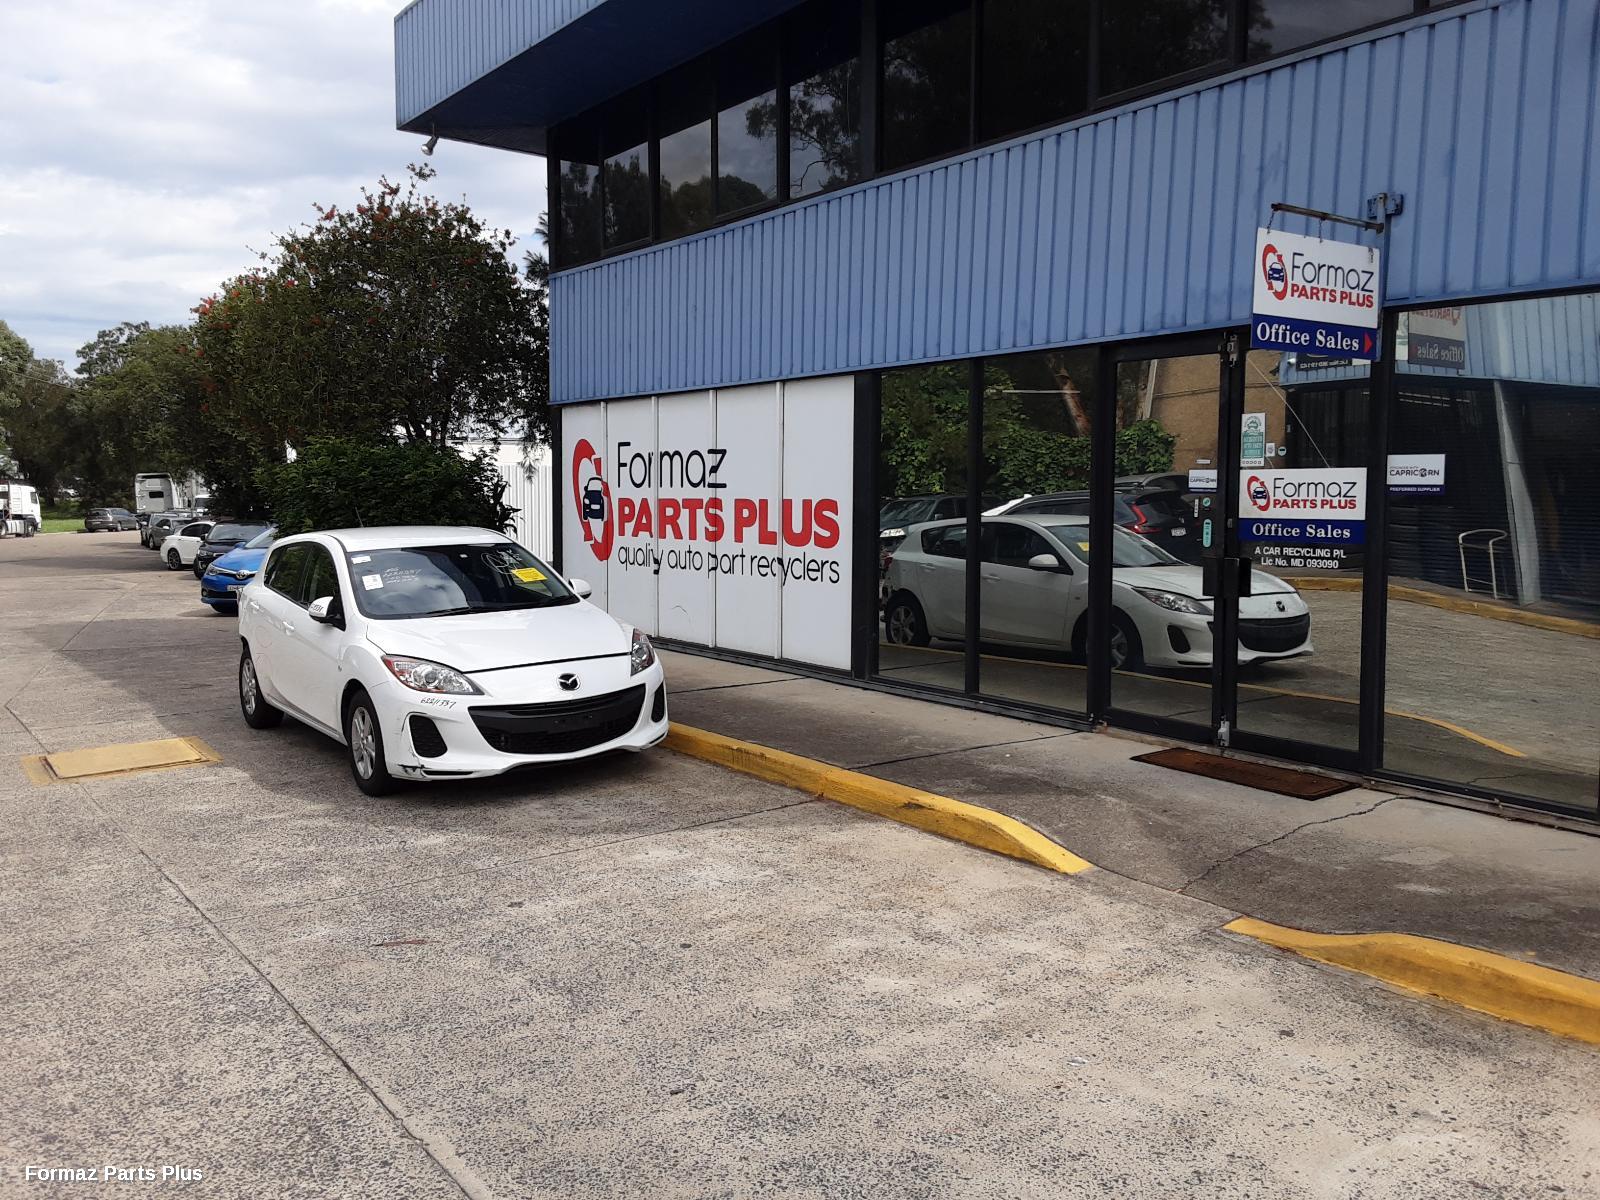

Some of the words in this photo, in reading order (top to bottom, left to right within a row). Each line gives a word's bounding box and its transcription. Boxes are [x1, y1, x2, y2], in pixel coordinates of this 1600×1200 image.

[1291, 252, 1374, 293] Formaz
[1290, 283, 1337, 303] PARTS
[1339, 290, 1374, 308] PLUS
[1256, 322, 1310, 345] Office
[1315, 329, 1360, 351] Sales
[617, 441, 727, 489] Formaz
[1273, 477, 1357, 498] Formaz
[1273, 499, 1318, 509] PARTS
[1320, 499, 1357, 510] PLUS
[617, 497, 725, 542] PARTS
[734, 498, 840, 549] PLUS
[1252, 522, 1300, 537] Office
[1305, 524, 1351, 539] Sales
[1254, 546, 1261, 555] A
[1262, 546, 1281, 555] CAR
[1282, 547, 1331, 558] RECYCLING
[1261, 557, 1273, 566] Lic
[1275, 557, 1289, 567] No.
[1290, 558, 1304, 567] MD
[1306, 558, 1339, 569] 093090
[667, 544, 704, 571] auto
[707, 547, 746, 579] part
[750, 551, 840, 587] recyclers
